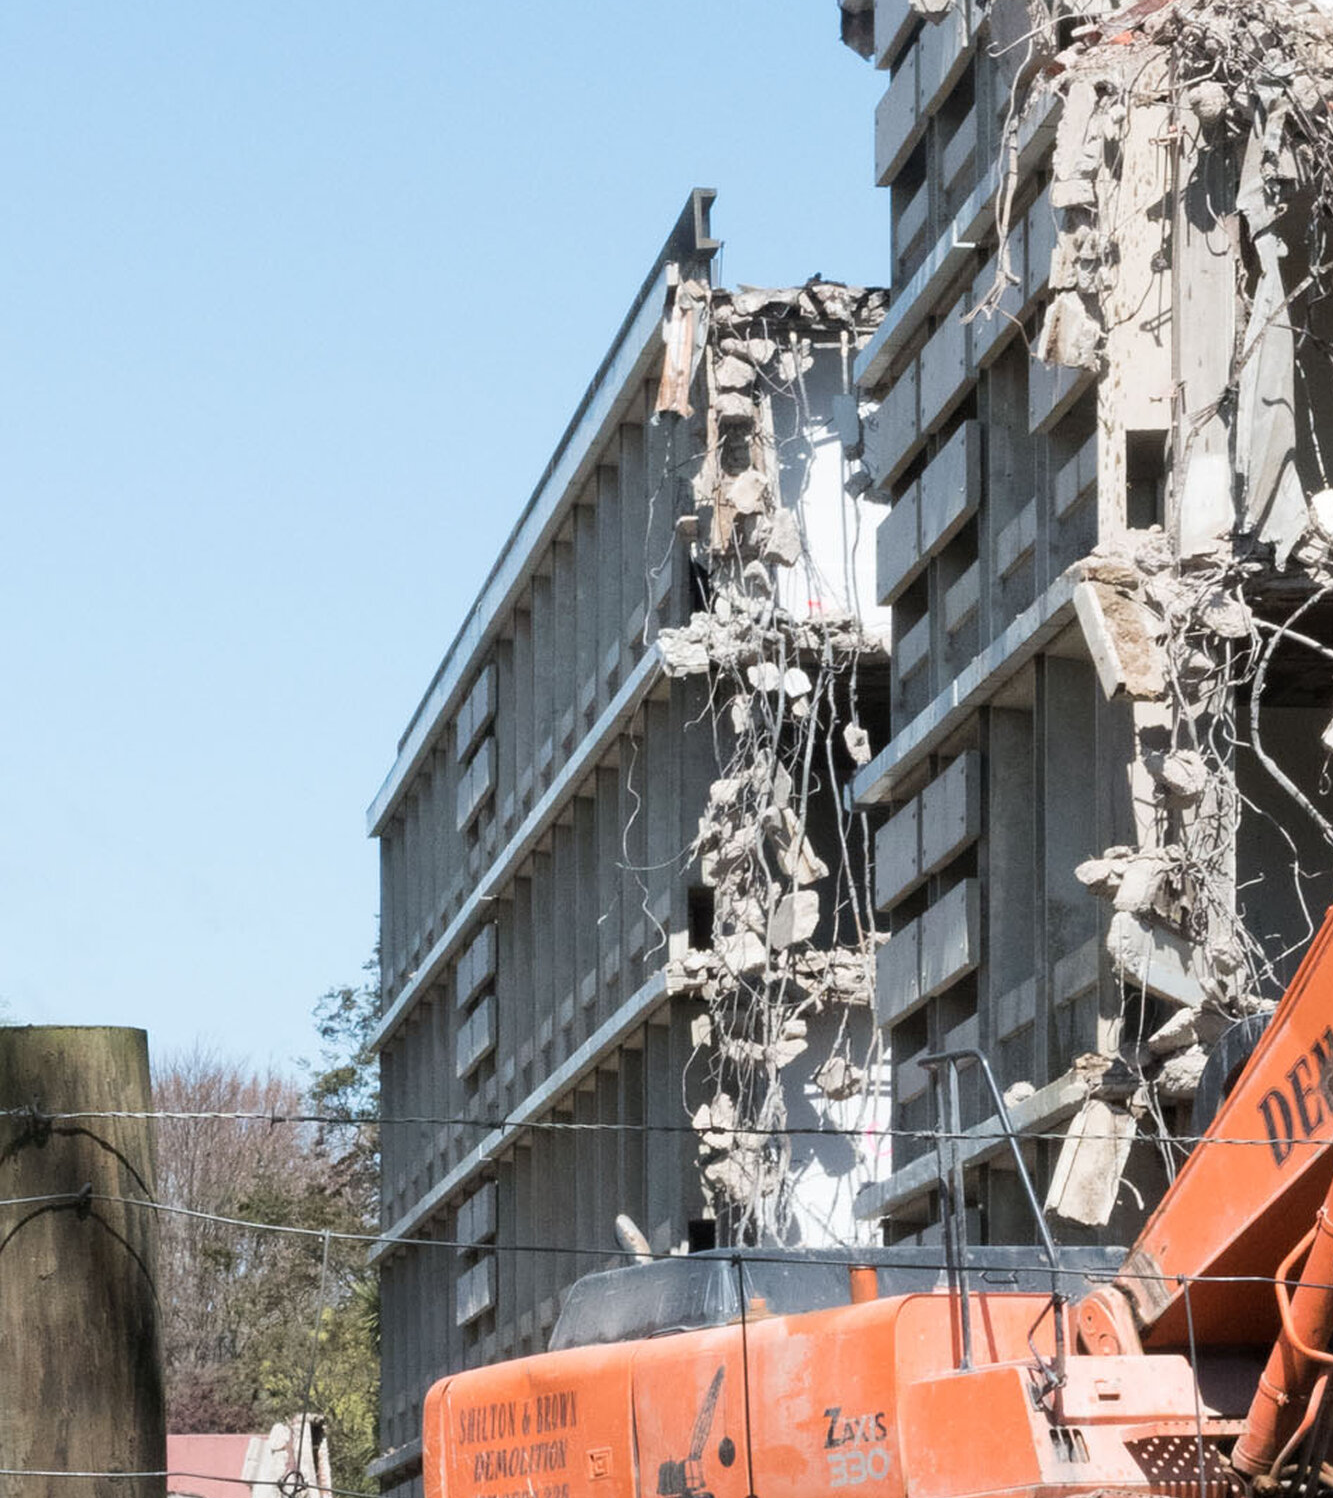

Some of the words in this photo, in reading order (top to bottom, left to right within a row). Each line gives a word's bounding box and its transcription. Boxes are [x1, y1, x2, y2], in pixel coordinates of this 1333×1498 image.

[459, 1402, 516, 1445] SHILTON
[536, 1391, 578, 1434] BROWN
[474, 1438, 568, 1483] DEMOLITION
[827, 1447, 890, 1487] 330
